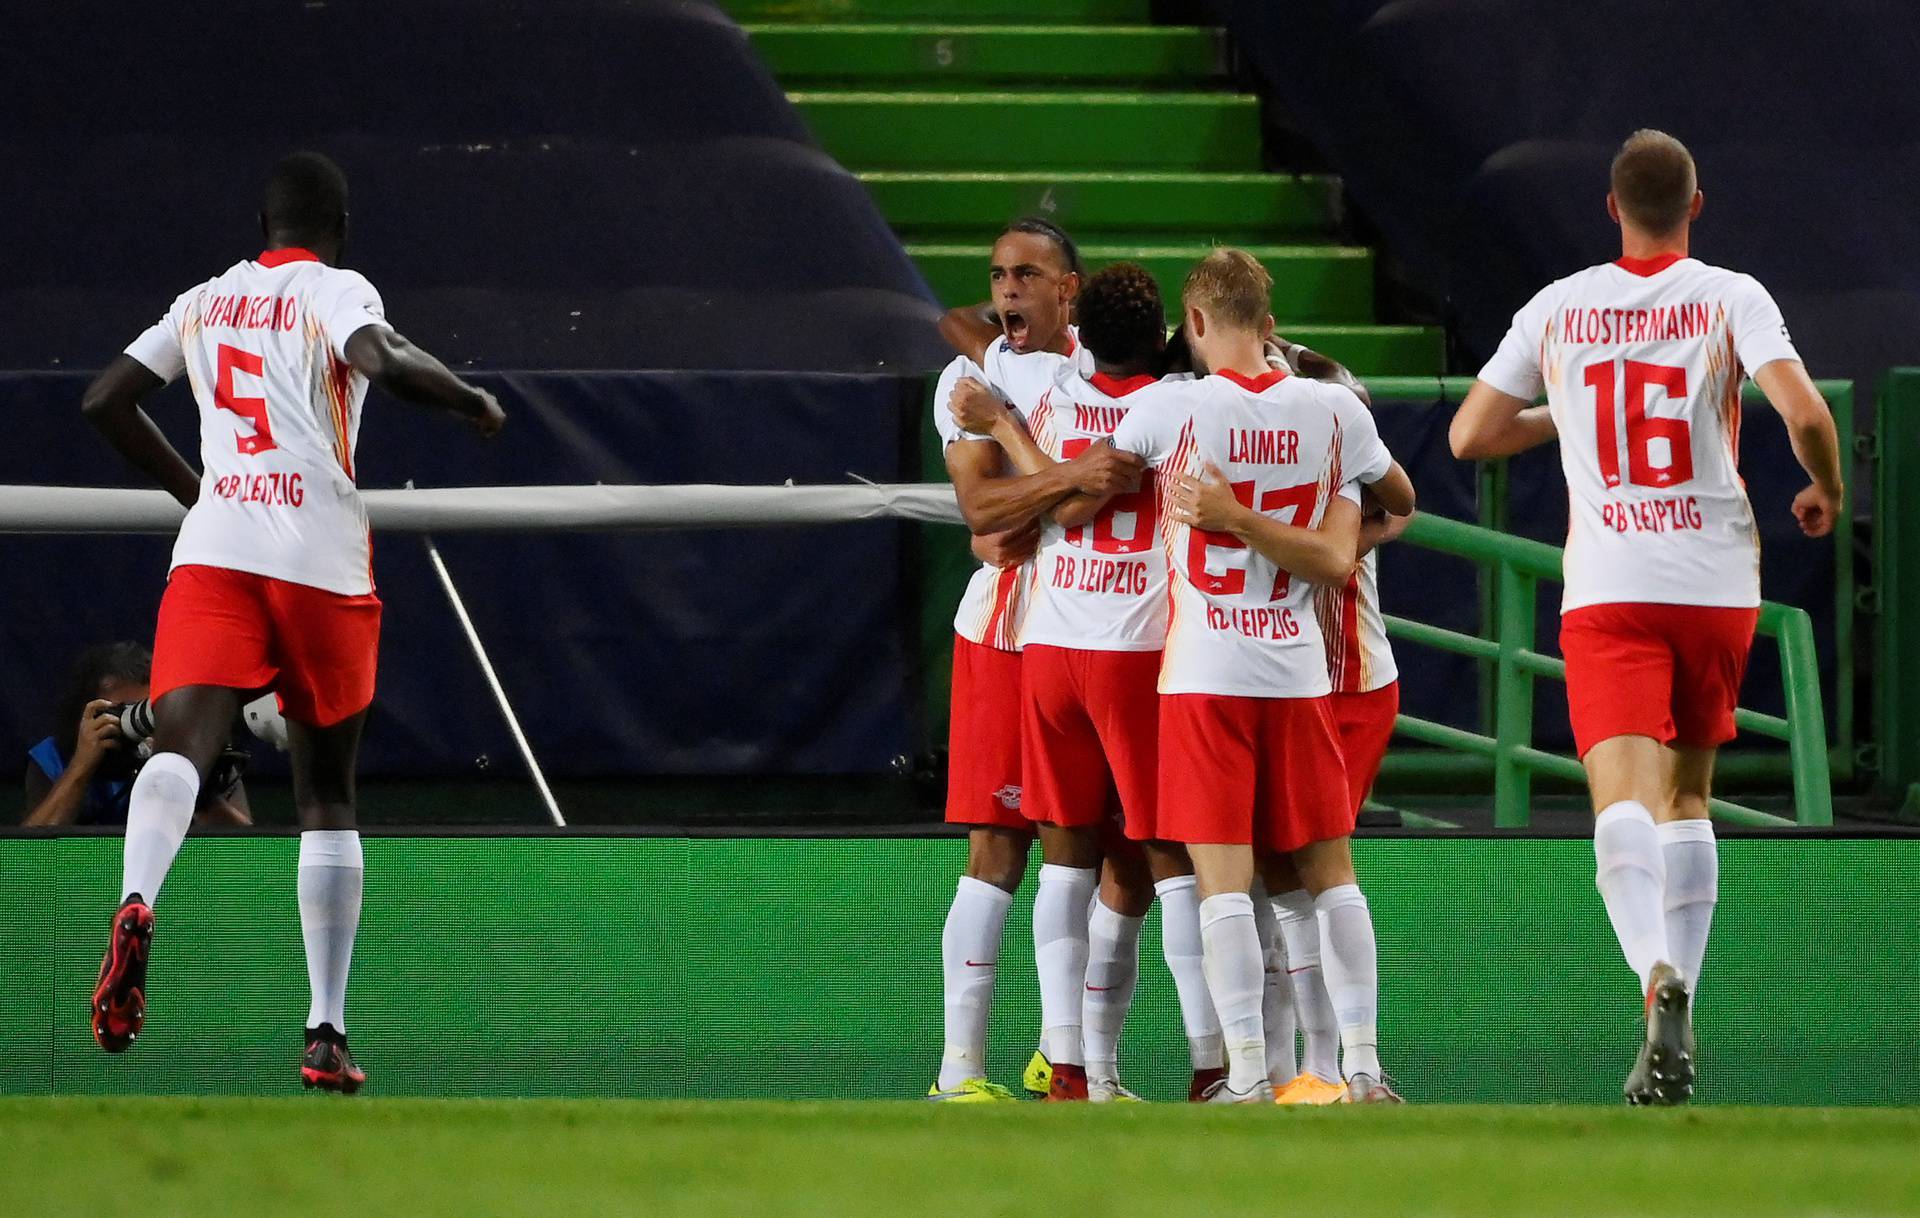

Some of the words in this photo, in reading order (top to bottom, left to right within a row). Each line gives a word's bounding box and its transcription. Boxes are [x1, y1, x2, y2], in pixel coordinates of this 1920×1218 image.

[936, 38, 953, 66] 5
[1040, 187, 1057, 214] 4
[1563, 302, 1710, 345] KLOSTERMANN
[214, 343, 278, 456] 5
[1584, 358, 1694, 489] 16
[1228, 428, 1299, 465] LAIMER
[213, 474, 241, 499] RB
[1603, 500, 1628, 533] RB
[1629, 496, 1702, 533] LEIPZIG
[1052, 555, 1076, 589] RB
[1078, 558, 1147, 596] LEIPZIG
[1231, 606, 1300, 640] LEIPZIG
